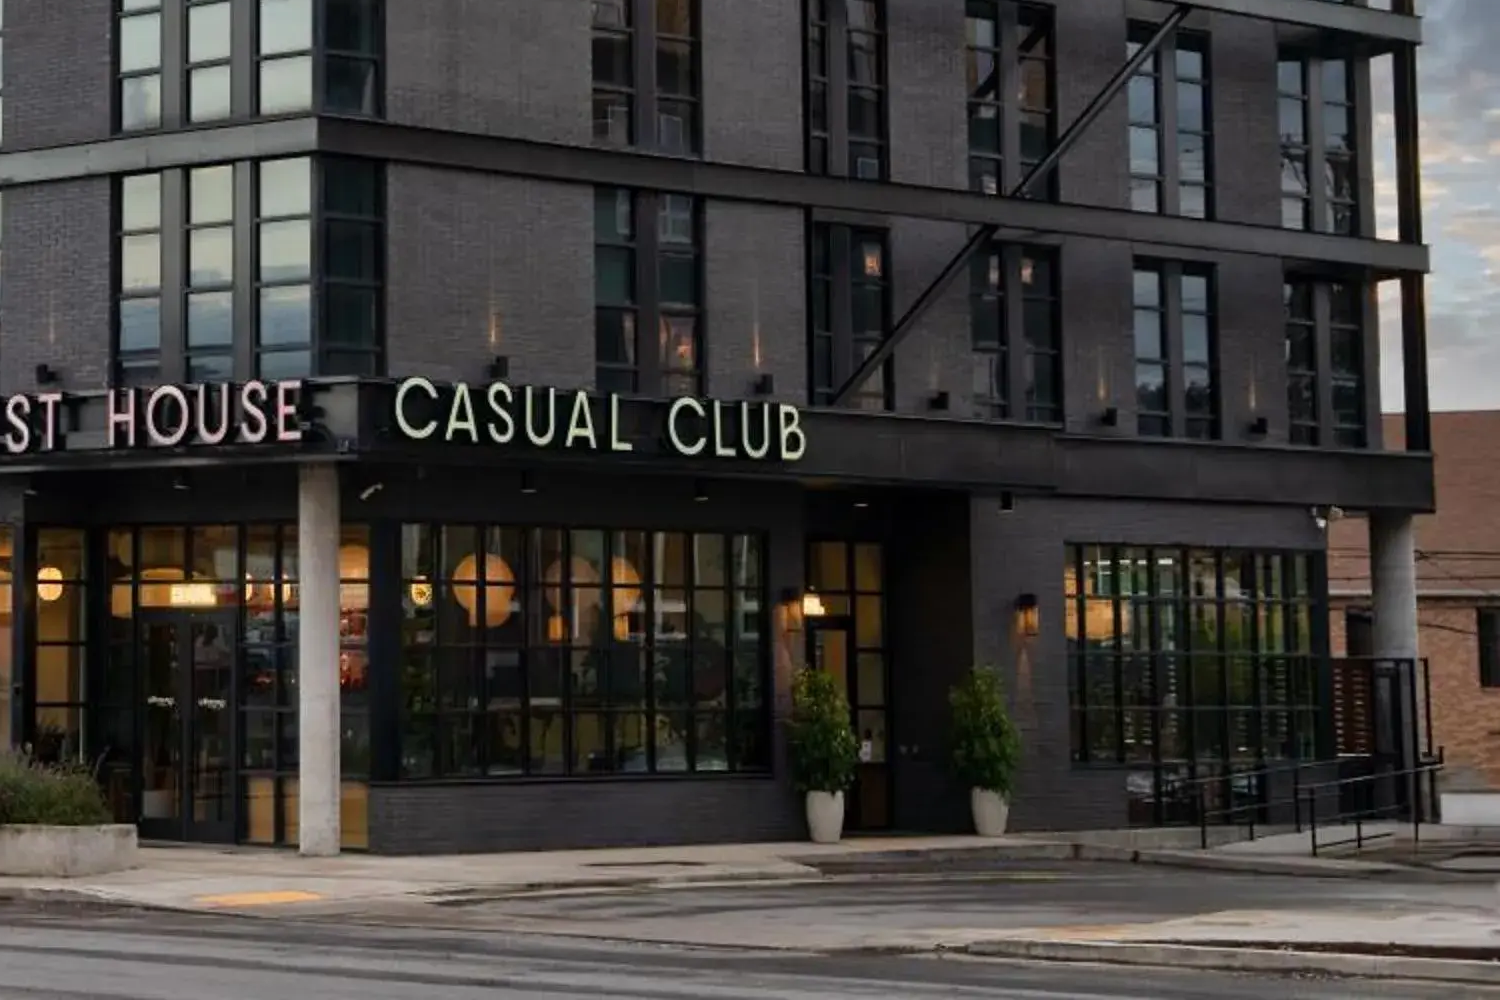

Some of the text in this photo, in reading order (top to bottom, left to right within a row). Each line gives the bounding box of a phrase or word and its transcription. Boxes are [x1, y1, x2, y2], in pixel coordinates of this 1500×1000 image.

[108, 380, 301, 447] HOUSE
[395, 377, 807, 461] CASUAL CLUB
